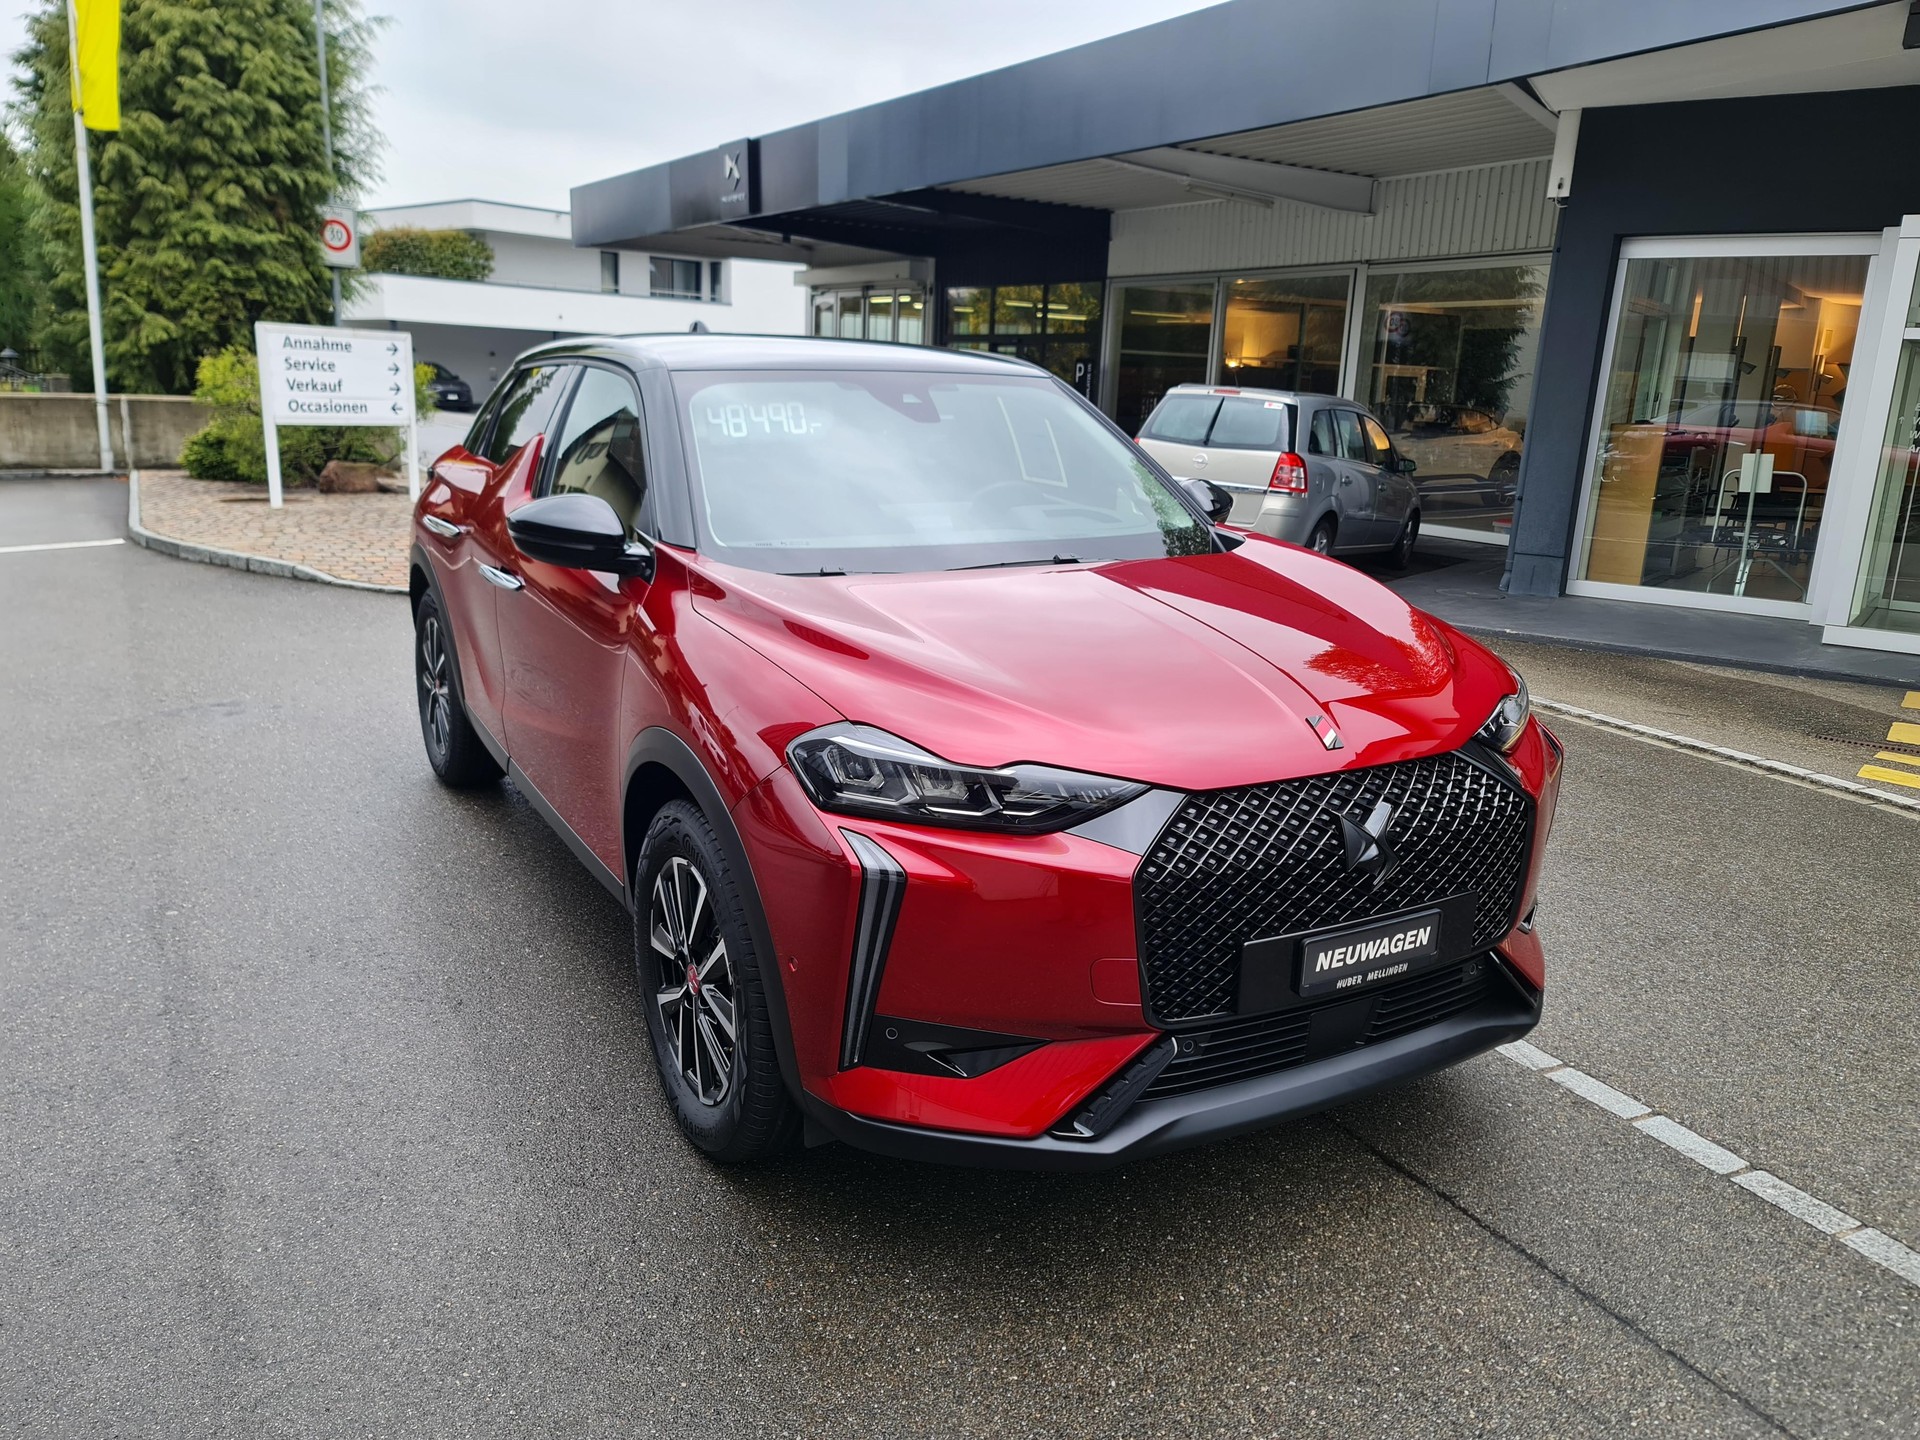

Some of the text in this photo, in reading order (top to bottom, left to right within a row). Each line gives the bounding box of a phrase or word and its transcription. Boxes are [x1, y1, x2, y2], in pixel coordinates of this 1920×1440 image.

[329, 227, 343, 242] 30
[282, 336, 352, 352] Annahme
[284, 357, 336, 372] Service
[286, 377, 343, 392] Verkauf
[288, 399, 368, 413] Occasionen
[1315, 926, 1431, 972] NEUWAGEN
[1336, 962, 1409, 989] HUBER MELLINGEN
